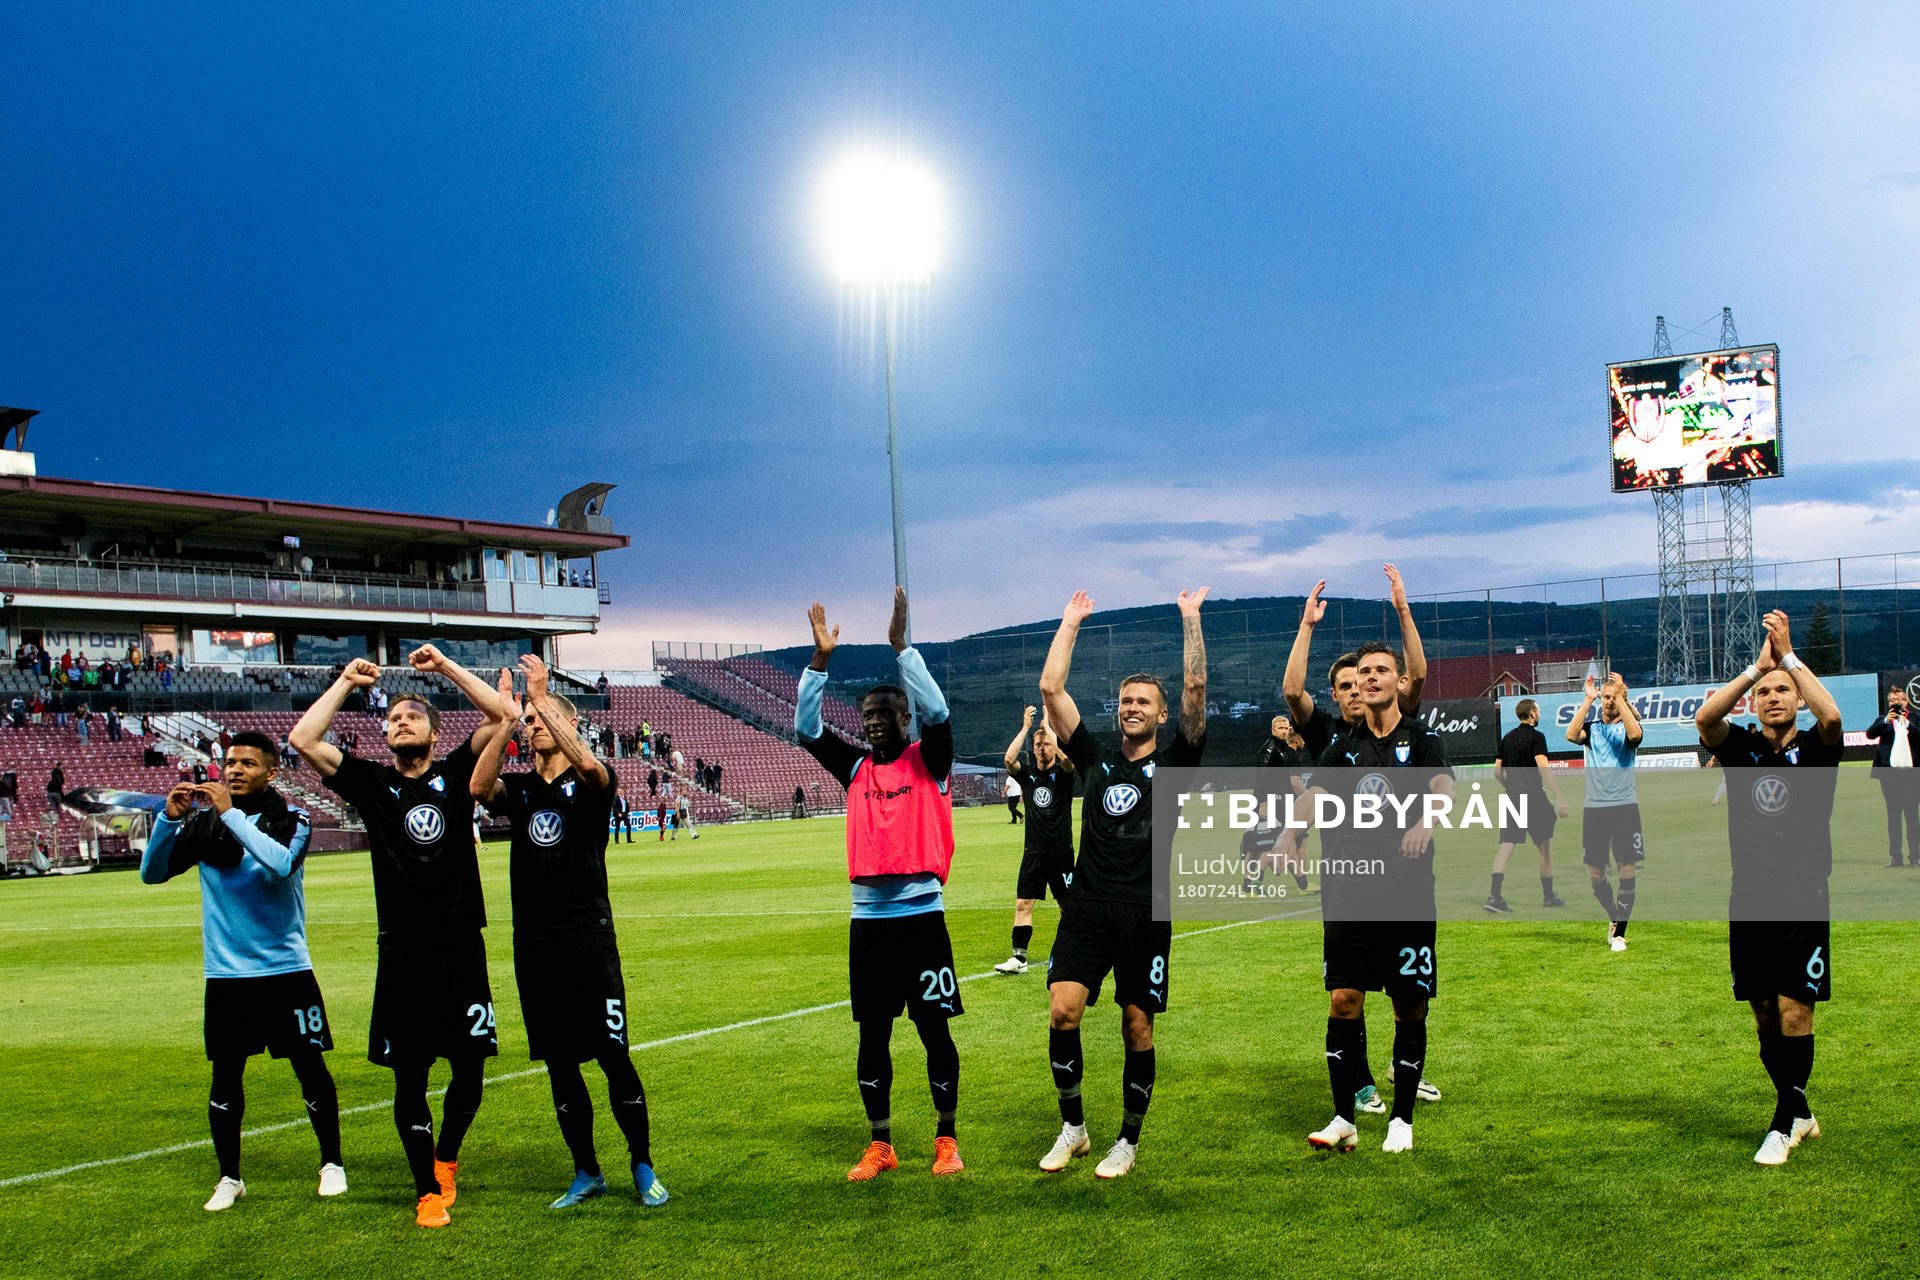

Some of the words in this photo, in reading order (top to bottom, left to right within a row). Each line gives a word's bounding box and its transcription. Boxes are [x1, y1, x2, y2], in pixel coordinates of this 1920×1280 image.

[46, 631, 86, 647] NTT
[1632, 832, 1644, 849] 3
[1150, 955, 1165, 985] 8
[1399, 946, 1433, 975] 23
[1806, 946, 1825, 979] 6
[919, 966, 956, 1001] 20
[294, 1005, 323, 1036] 18
[606, 998, 624, 1031] 5
